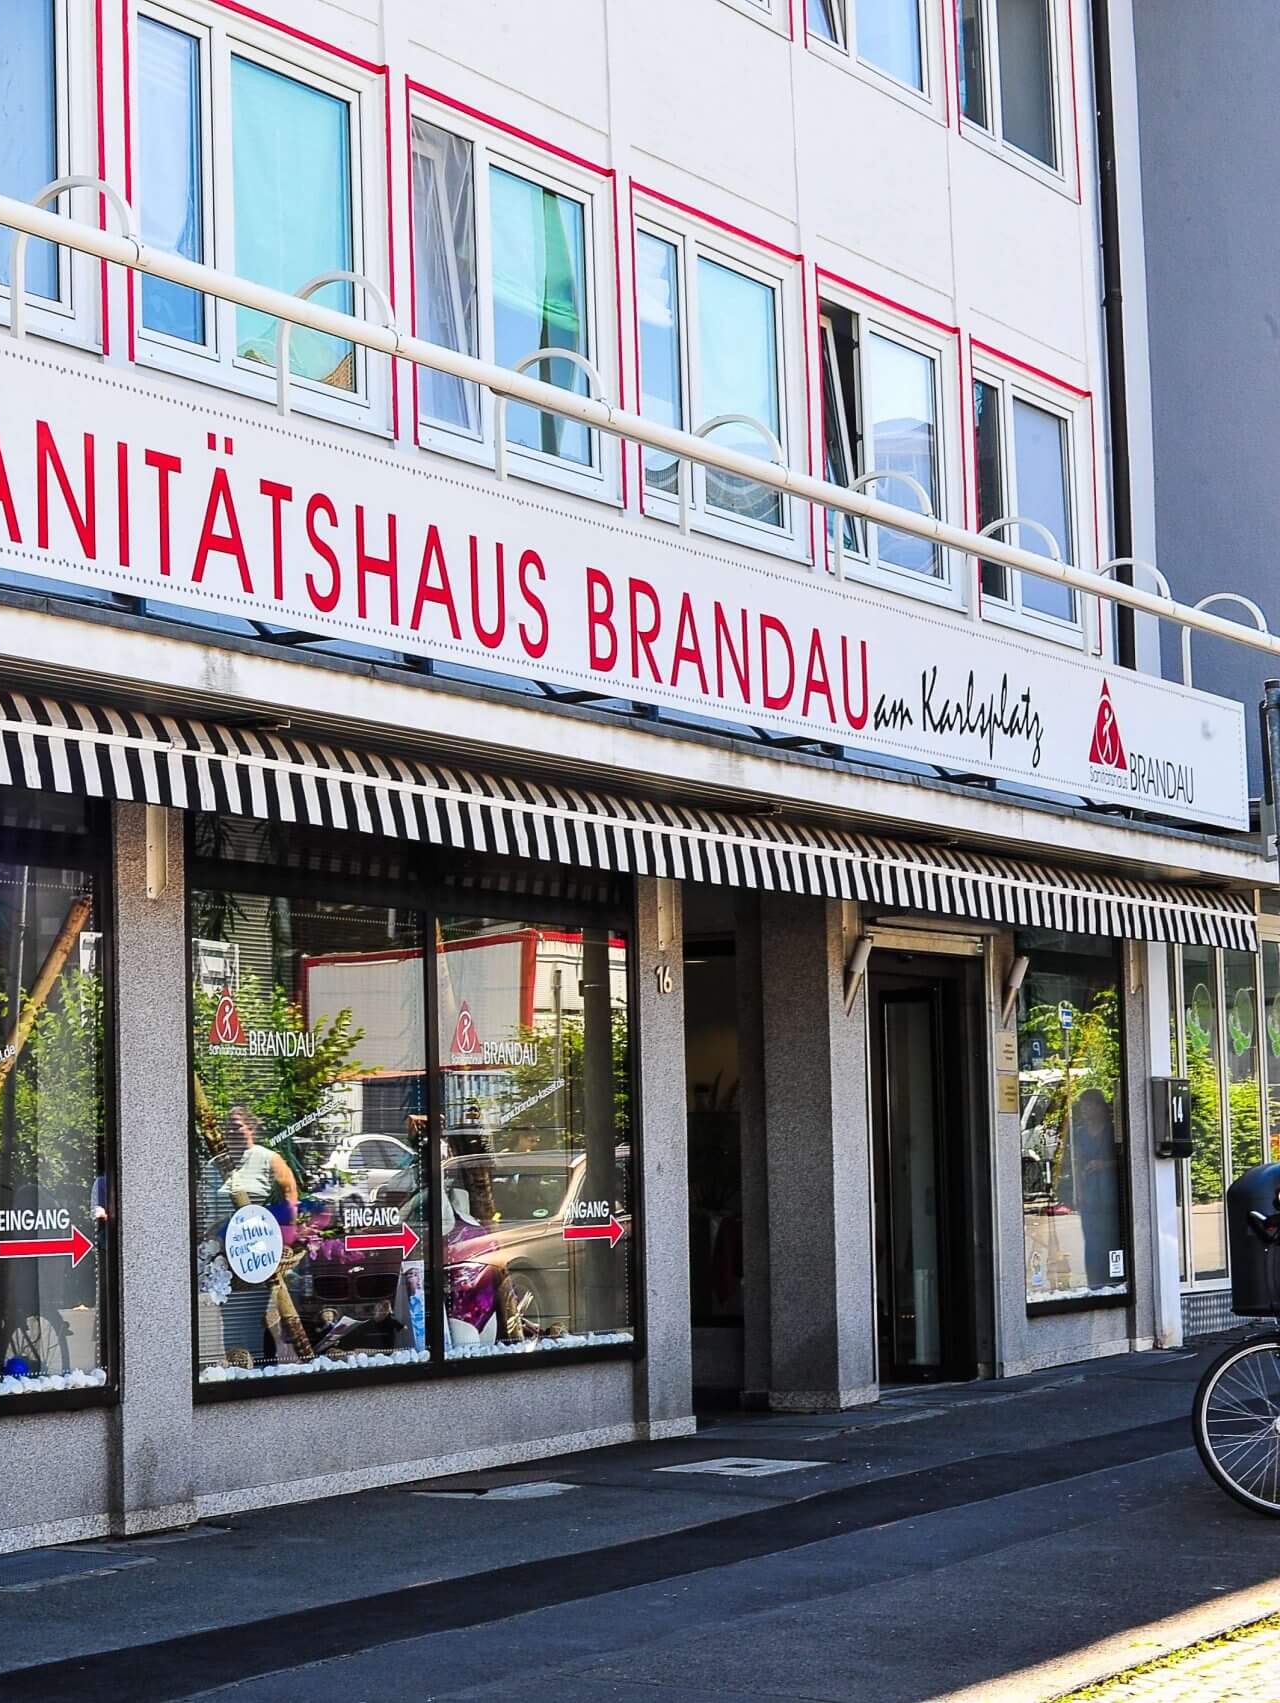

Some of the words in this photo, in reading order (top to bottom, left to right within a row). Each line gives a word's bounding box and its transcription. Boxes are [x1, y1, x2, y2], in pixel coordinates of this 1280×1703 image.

[586, 567, 869, 731] BRANDAU
[874, 694, 913, 731] am
[921, 665, 1044, 768] Karlsplatz
[1129, 752, 1195, 805] BRANDAU
[656, 965, 673, 993] 16
[249, 1030, 315, 1058] BRANDAU
[483, 1041, 538, 1066] BRANDAU
[1173, 1096, 1183, 1123] 14
[343, 1202, 400, 1228] EINGANG
